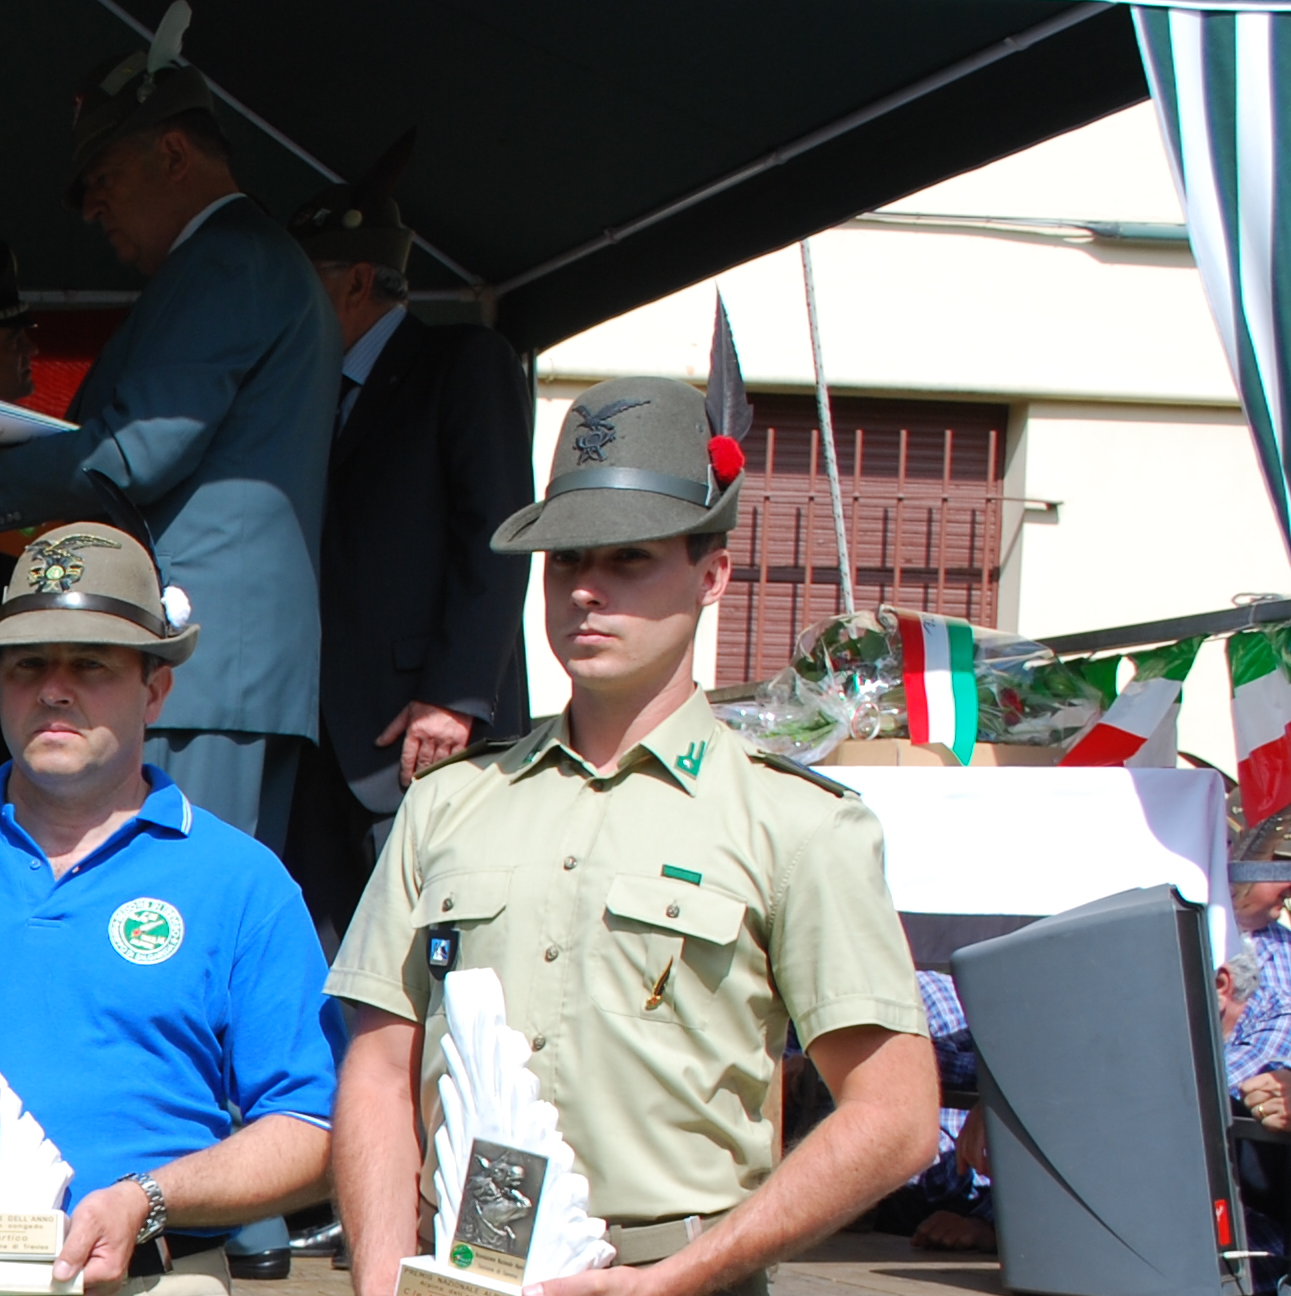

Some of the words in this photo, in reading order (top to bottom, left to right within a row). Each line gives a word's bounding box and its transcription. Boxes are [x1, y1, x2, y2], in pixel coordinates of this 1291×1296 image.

[8, 1215, 54, 1223] DELL'ANNO
[404, 1268, 433, 1281] PREMIO
[437, 1277, 480, 1294] NAZIONALE
[420, 1280, 444, 1292] Alpino
